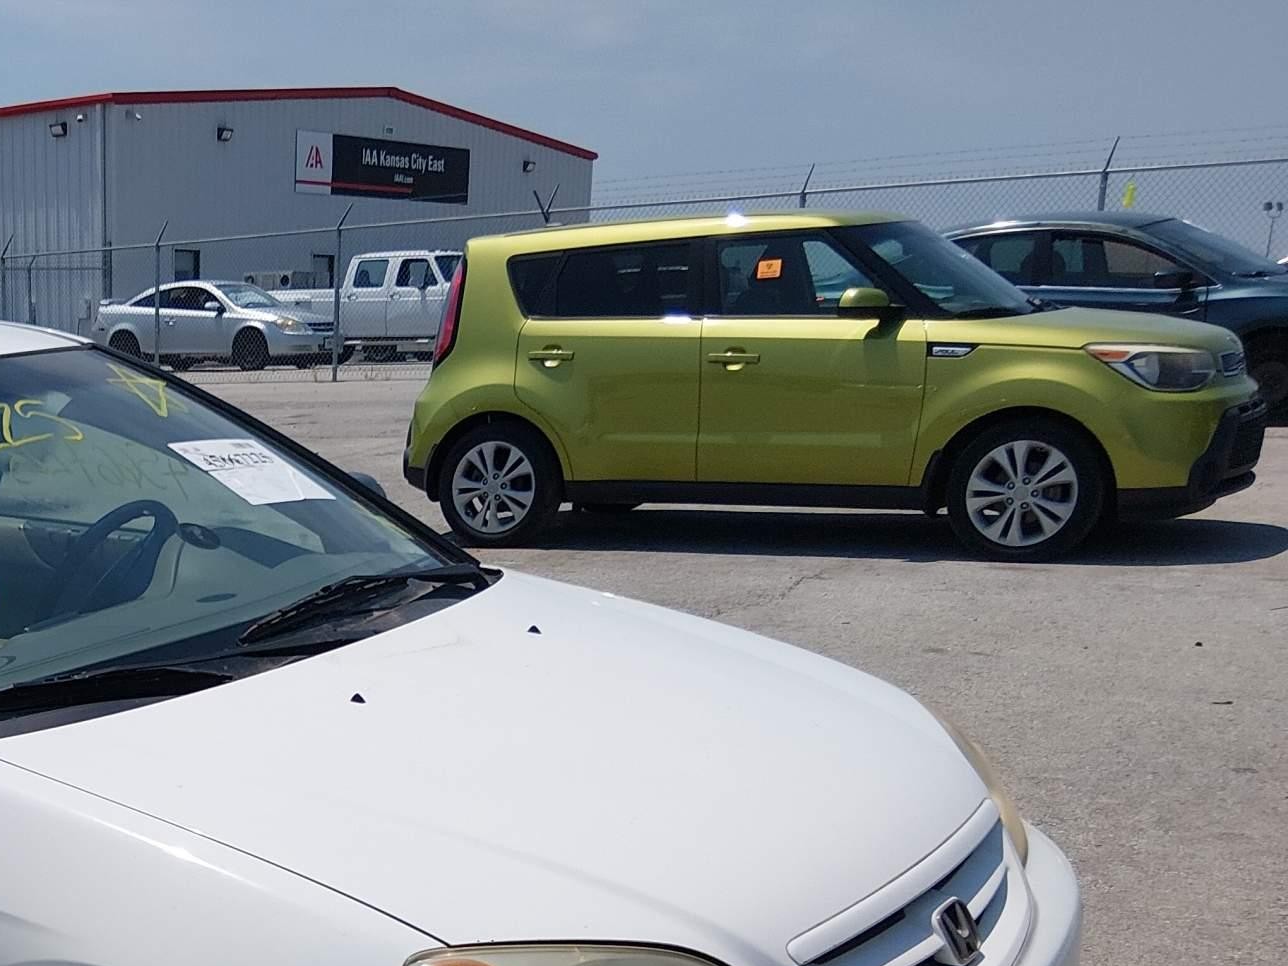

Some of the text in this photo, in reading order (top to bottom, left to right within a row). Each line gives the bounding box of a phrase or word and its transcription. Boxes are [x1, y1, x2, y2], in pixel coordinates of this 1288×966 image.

[362, 147, 445, 174] IAA Kansas City East
